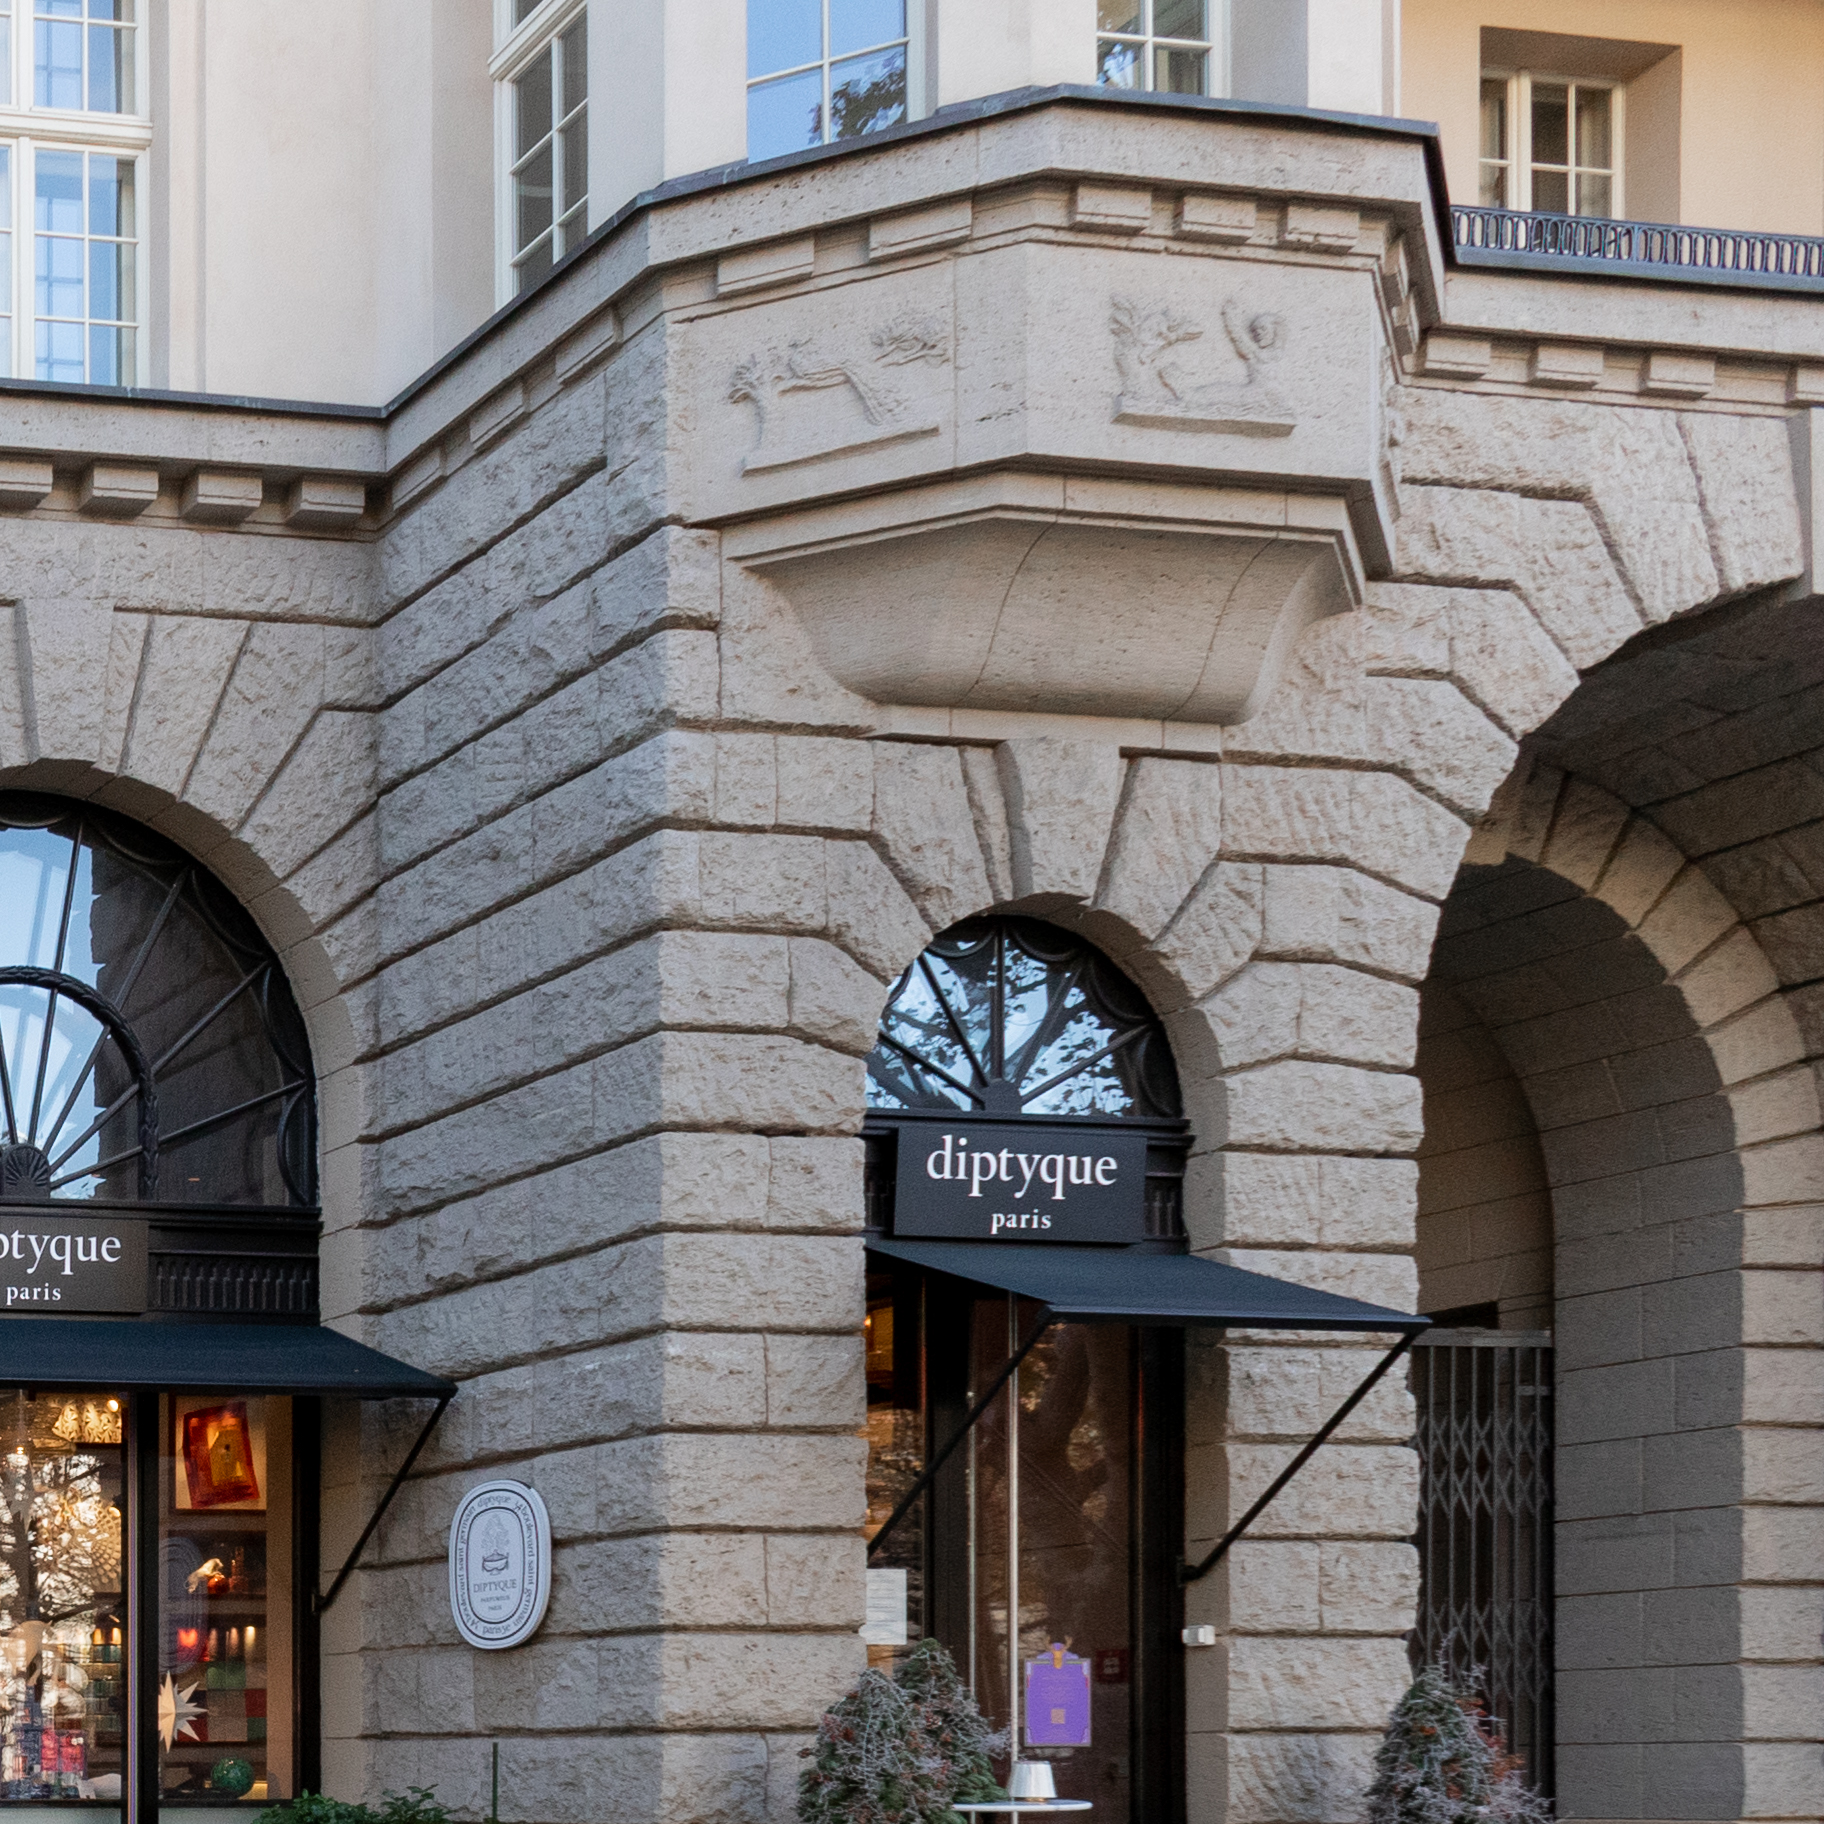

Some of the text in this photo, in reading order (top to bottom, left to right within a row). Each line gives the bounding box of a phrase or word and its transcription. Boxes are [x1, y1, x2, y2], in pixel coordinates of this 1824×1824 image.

[926, 1135, 1118, 1200] diptyque
[990, 1208, 1052, 1235] paris
[6, 1282, 62, 1306] paris
[473, 1578, 517, 1593] DIPTYQUE
